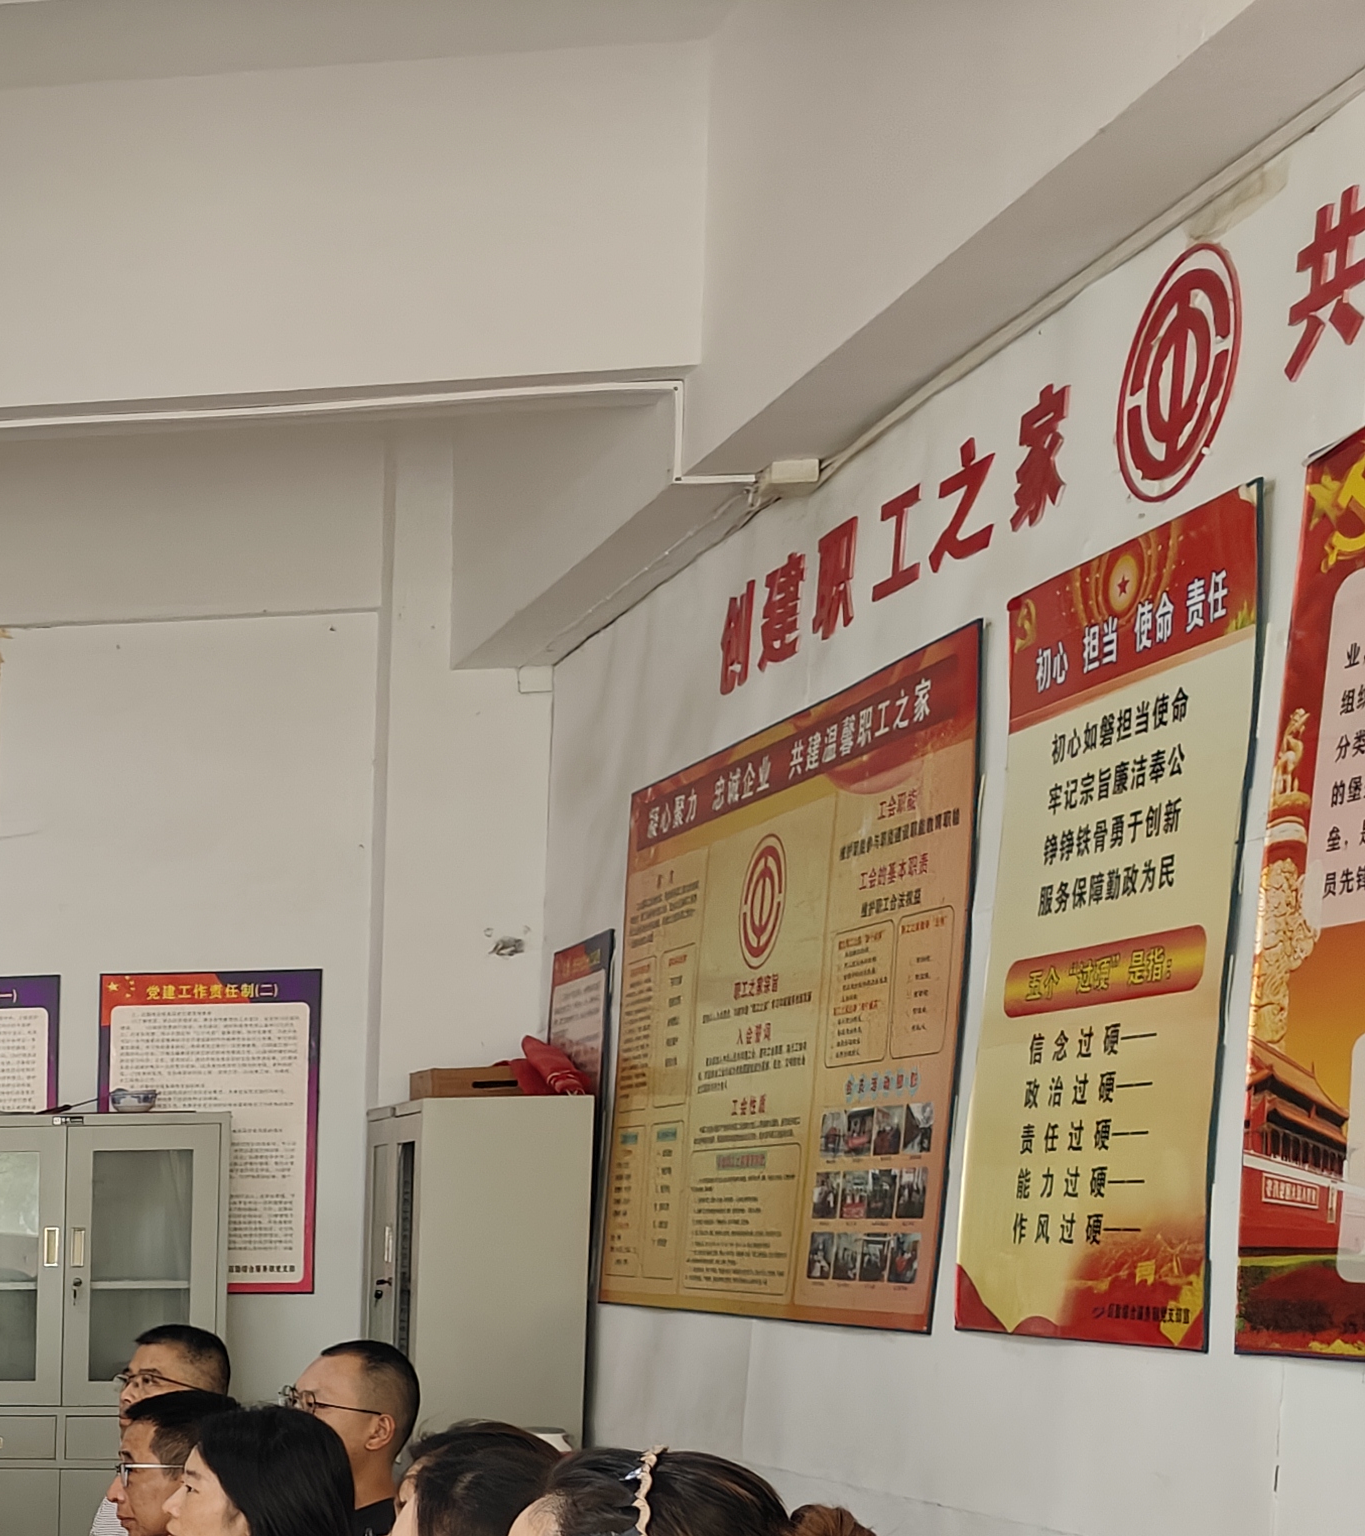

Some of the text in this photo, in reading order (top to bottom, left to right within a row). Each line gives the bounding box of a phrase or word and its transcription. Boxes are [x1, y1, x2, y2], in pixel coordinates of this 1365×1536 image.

[719, 382, 1073, 696] 创建职工之家
[1035, 569, 1230, 694] 初心 担当 使命 责任
[646, 678, 932, 839] 凝心聚力 忠诚企业 共建温馨职工之家
[1051, 686, 1190, 766] 初心如磐担当使命
[1047, 743, 1186, 817] 牢记宗旨廉洁奉公
[1330, 773, 1365, 808] 的堡
[1043, 797, 1183, 867] 铮铮铁骨勇于创新
[1037, 853, 1177, 918] 服务保障勤政为民
